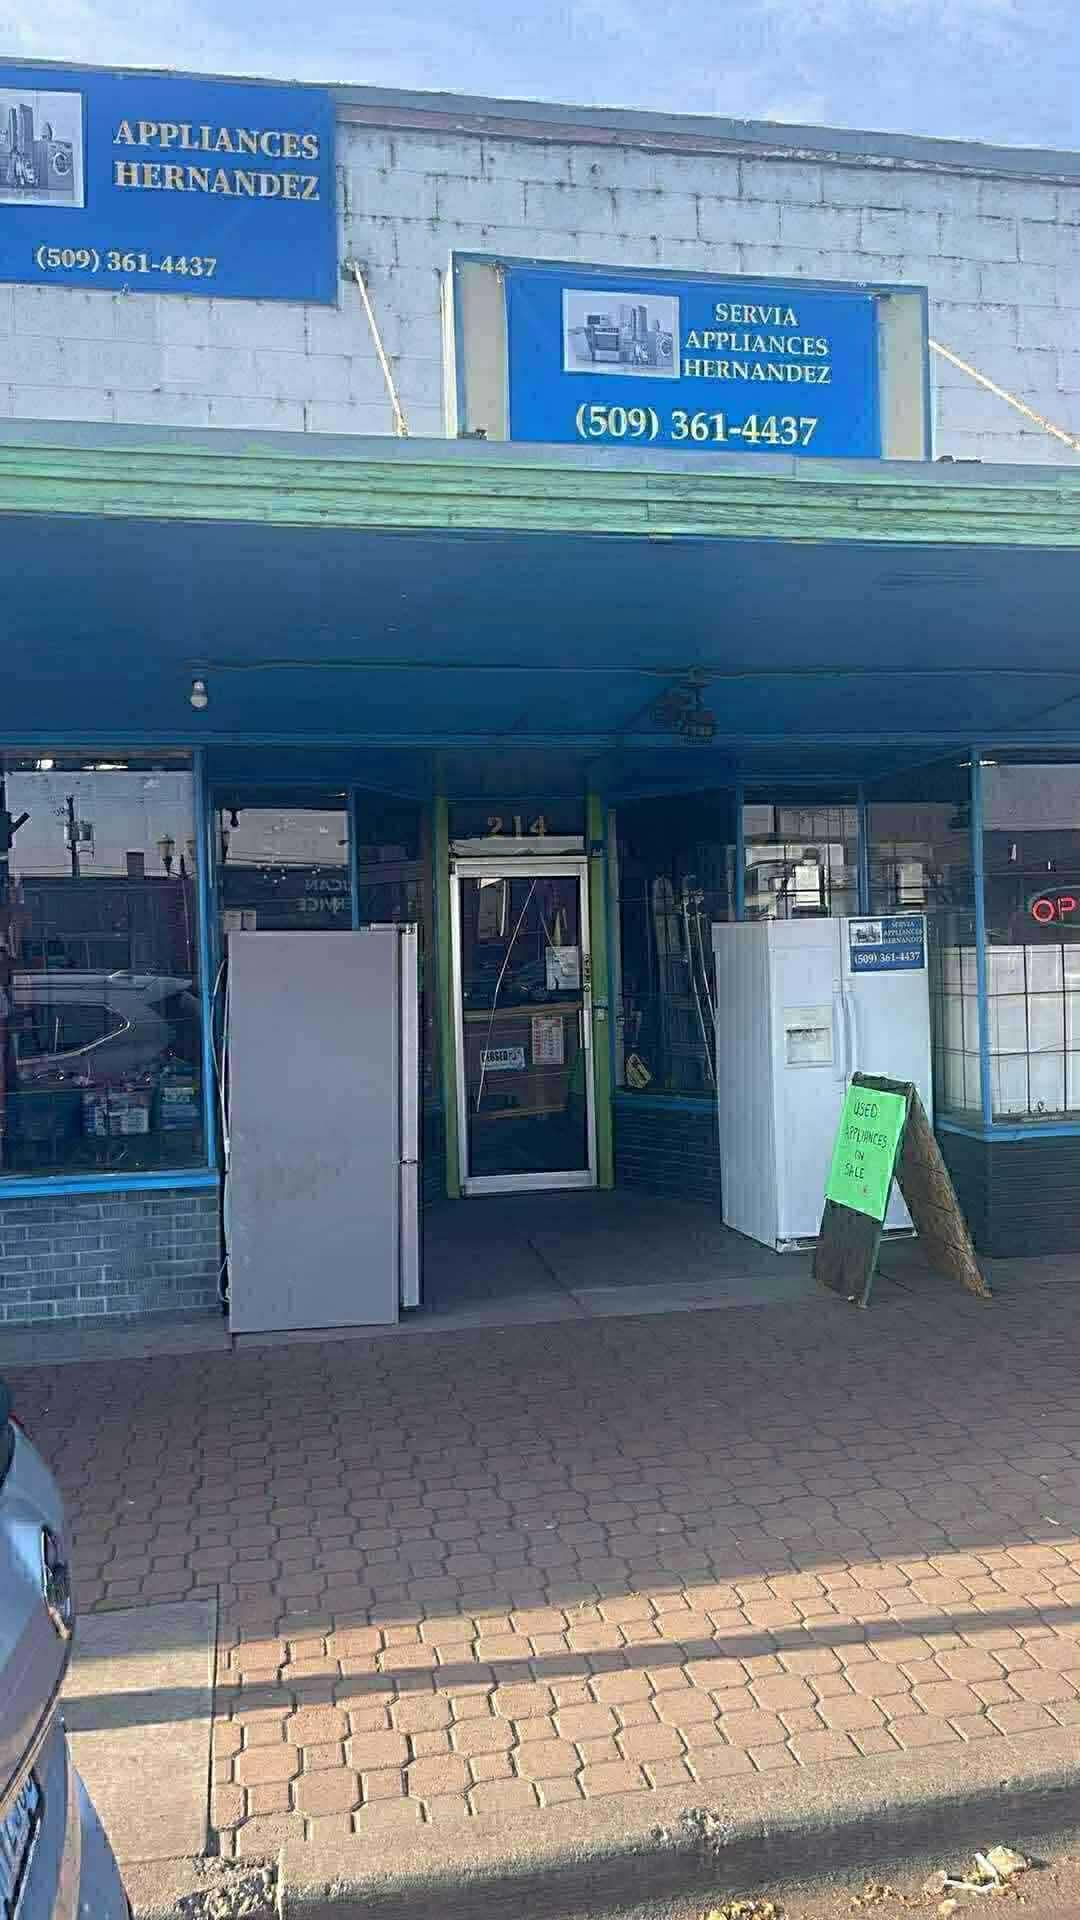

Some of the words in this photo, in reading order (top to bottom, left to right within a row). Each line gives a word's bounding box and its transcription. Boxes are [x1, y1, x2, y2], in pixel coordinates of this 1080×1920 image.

[113, 120, 319, 160] APPLIANCES
[113, 160, 320, 200] HERNANDEZ
[36, 245, 100, 273] (509)
[107, 250, 217, 277] 361-4437
[715, 303, 799, 327] SERVIA
[685, 330, 829, 357] APPLIANCES
[683, 358, 832, 385] HERNANDEZ
[575, 403, 659, 441] (509)
[671, 411, 817, 446] 361-4437
[487, 816, 545, 840] 214
[883, 928, 922, 937] APPLIANCES
[855, 952, 877, 965] (509)
[880, 951, 920, 961] 361-4437
[854, 1102, 878, 1118] USED
[845, 1124, 888, 1149] APPLIANCES
[844, 1162, 865, 1179] SALE
